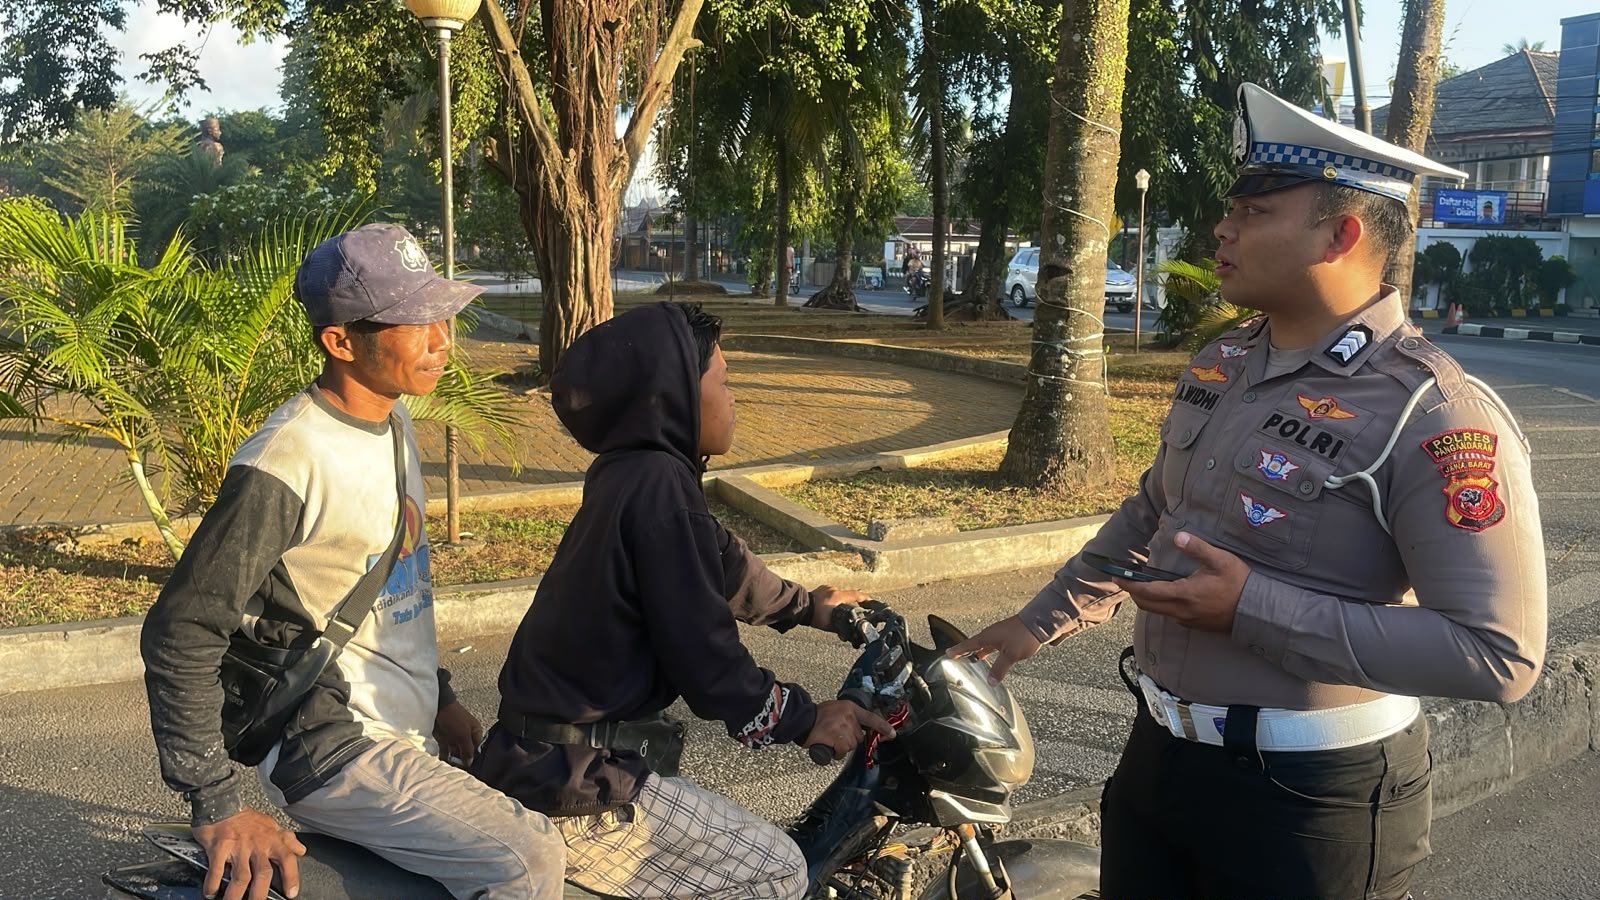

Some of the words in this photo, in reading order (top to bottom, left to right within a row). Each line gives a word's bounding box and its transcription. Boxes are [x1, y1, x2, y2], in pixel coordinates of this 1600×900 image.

[1439, 197, 1461, 206] Daftar
[1462, 198, 1476, 209] Haji
[1456, 207, 1476, 216] Disini
[1262, 413, 1344, 459] POLRI
[1432, 432, 1491, 449] POLRES
[1433, 441, 1494, 458] PANGANDARAN
[1445, 462, 1466, 473] JAWA
[1467, 461, 1493, 469] BARAT
